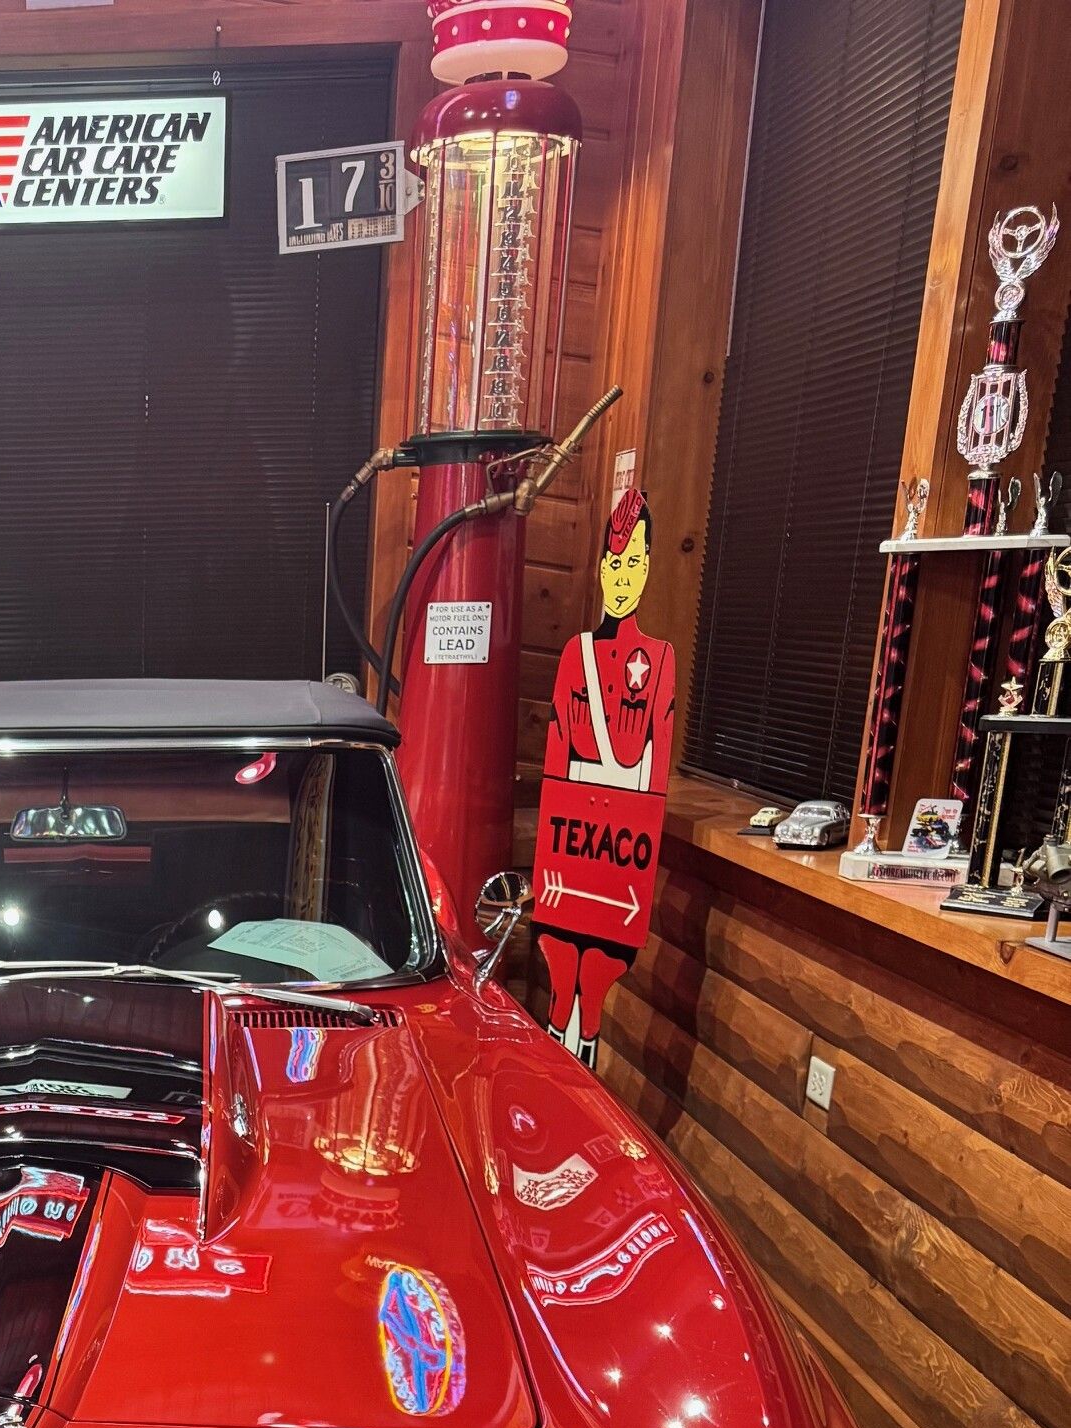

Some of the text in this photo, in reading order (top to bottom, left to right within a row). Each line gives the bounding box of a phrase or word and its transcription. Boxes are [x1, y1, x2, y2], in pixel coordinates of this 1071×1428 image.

[30, 112, 212, 146] AMERICAN
[21, 145, 181, 177] CAR CARE
[379, 151, 395, 180] 3
[13, 176, 162, 208] CENTERS
[378, 183, 396, 212] 10
[432, 626, 484, 636] CONTAINS
[439, 638, 475, 651] LEAD
[550, 816, 652, 870] TEXACO
